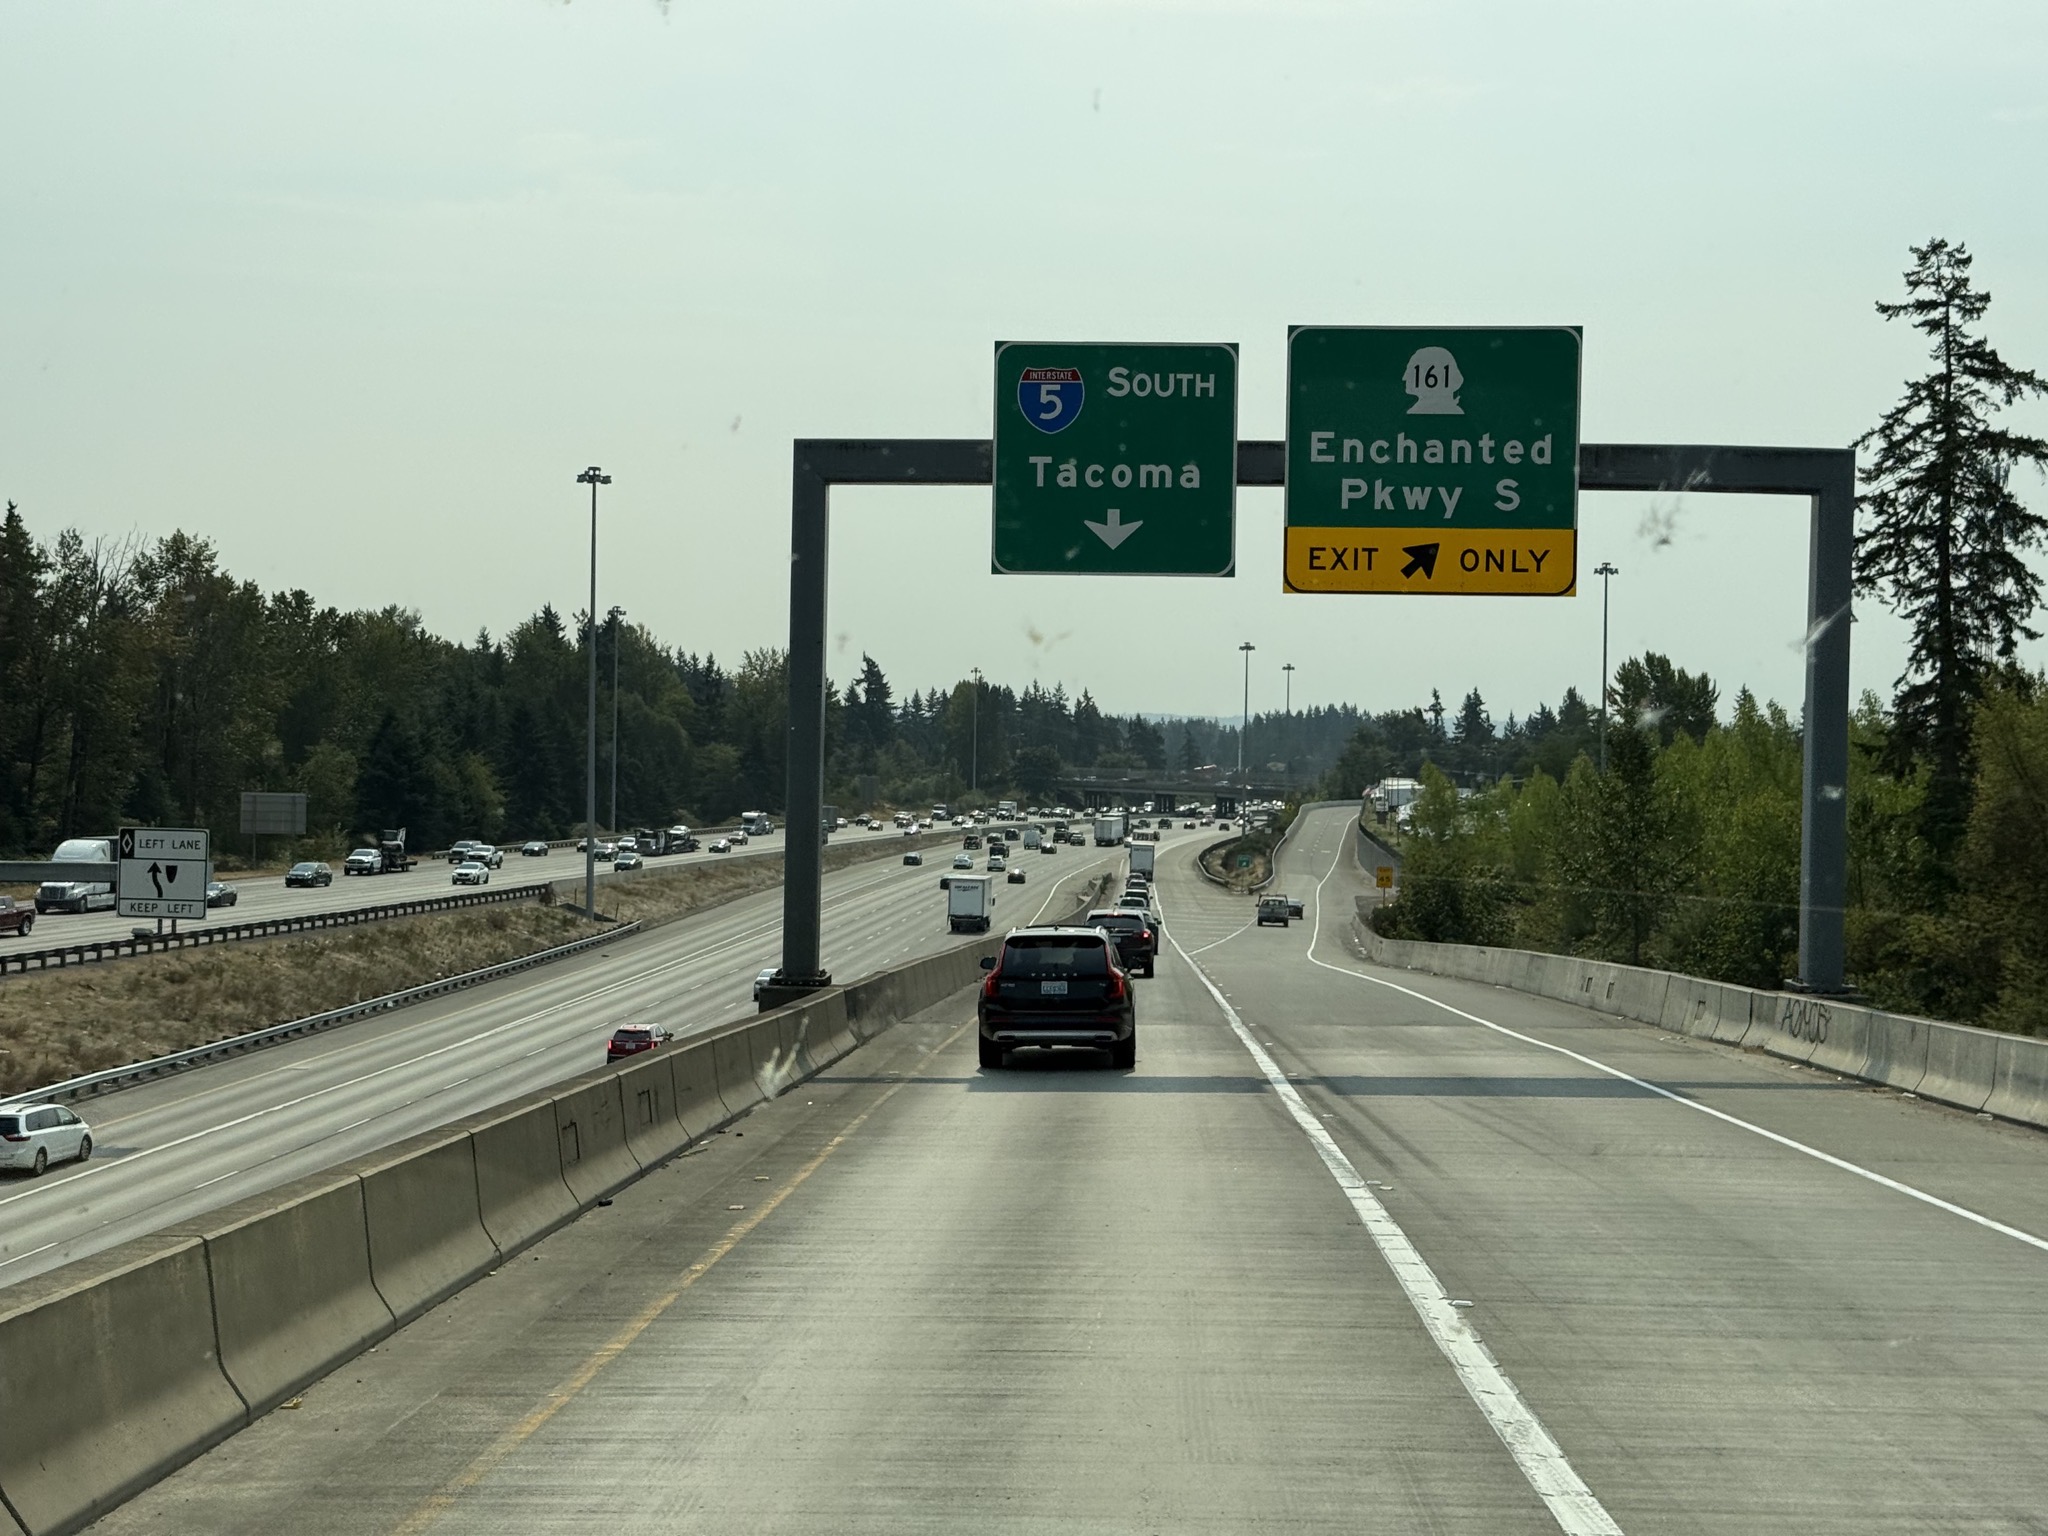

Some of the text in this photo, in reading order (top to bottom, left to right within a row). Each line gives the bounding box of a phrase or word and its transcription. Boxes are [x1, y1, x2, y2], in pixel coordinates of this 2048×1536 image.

[1029, 371, 1073, 381] INTERSTATE
[1106, 366, 1215, 398] SOUTH
[1413, 364, 1449, 388] 161
[1039, 384, 1063, 420] 5
[1310, 431, 1552, 465] Enchanted
[1028, 456, 1200, 488] Tacoma
[1341, 478, 1521, 519] Pkwy S
[1308, 547, 1551, 573] EXIT ONLY
[139, 839, 200, 850] LEFT LANE
[130, 902, 193, 914] KEEP LEFT
